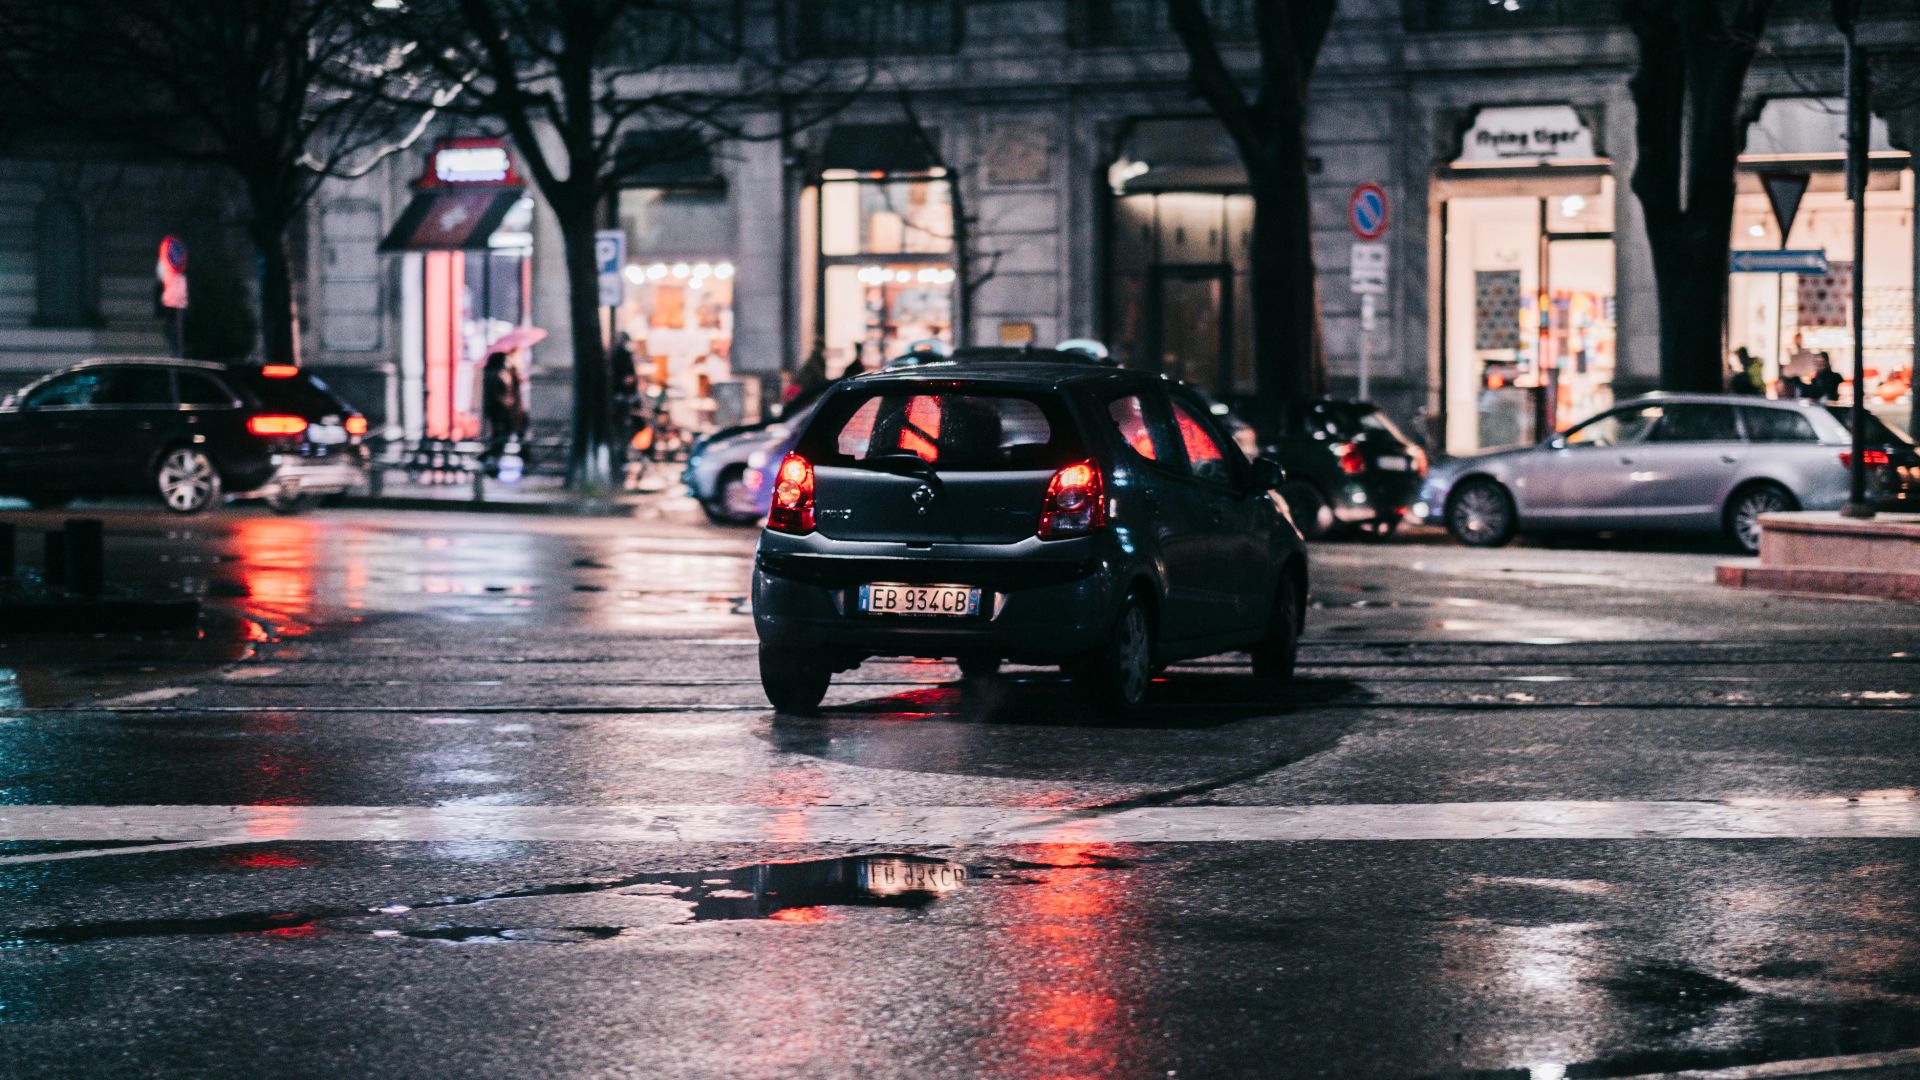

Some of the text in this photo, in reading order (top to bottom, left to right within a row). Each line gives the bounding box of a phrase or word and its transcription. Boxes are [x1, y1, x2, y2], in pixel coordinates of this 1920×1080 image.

[597, 240, 616, 272] P
[873, 588, 967, 612] EB 934CB
